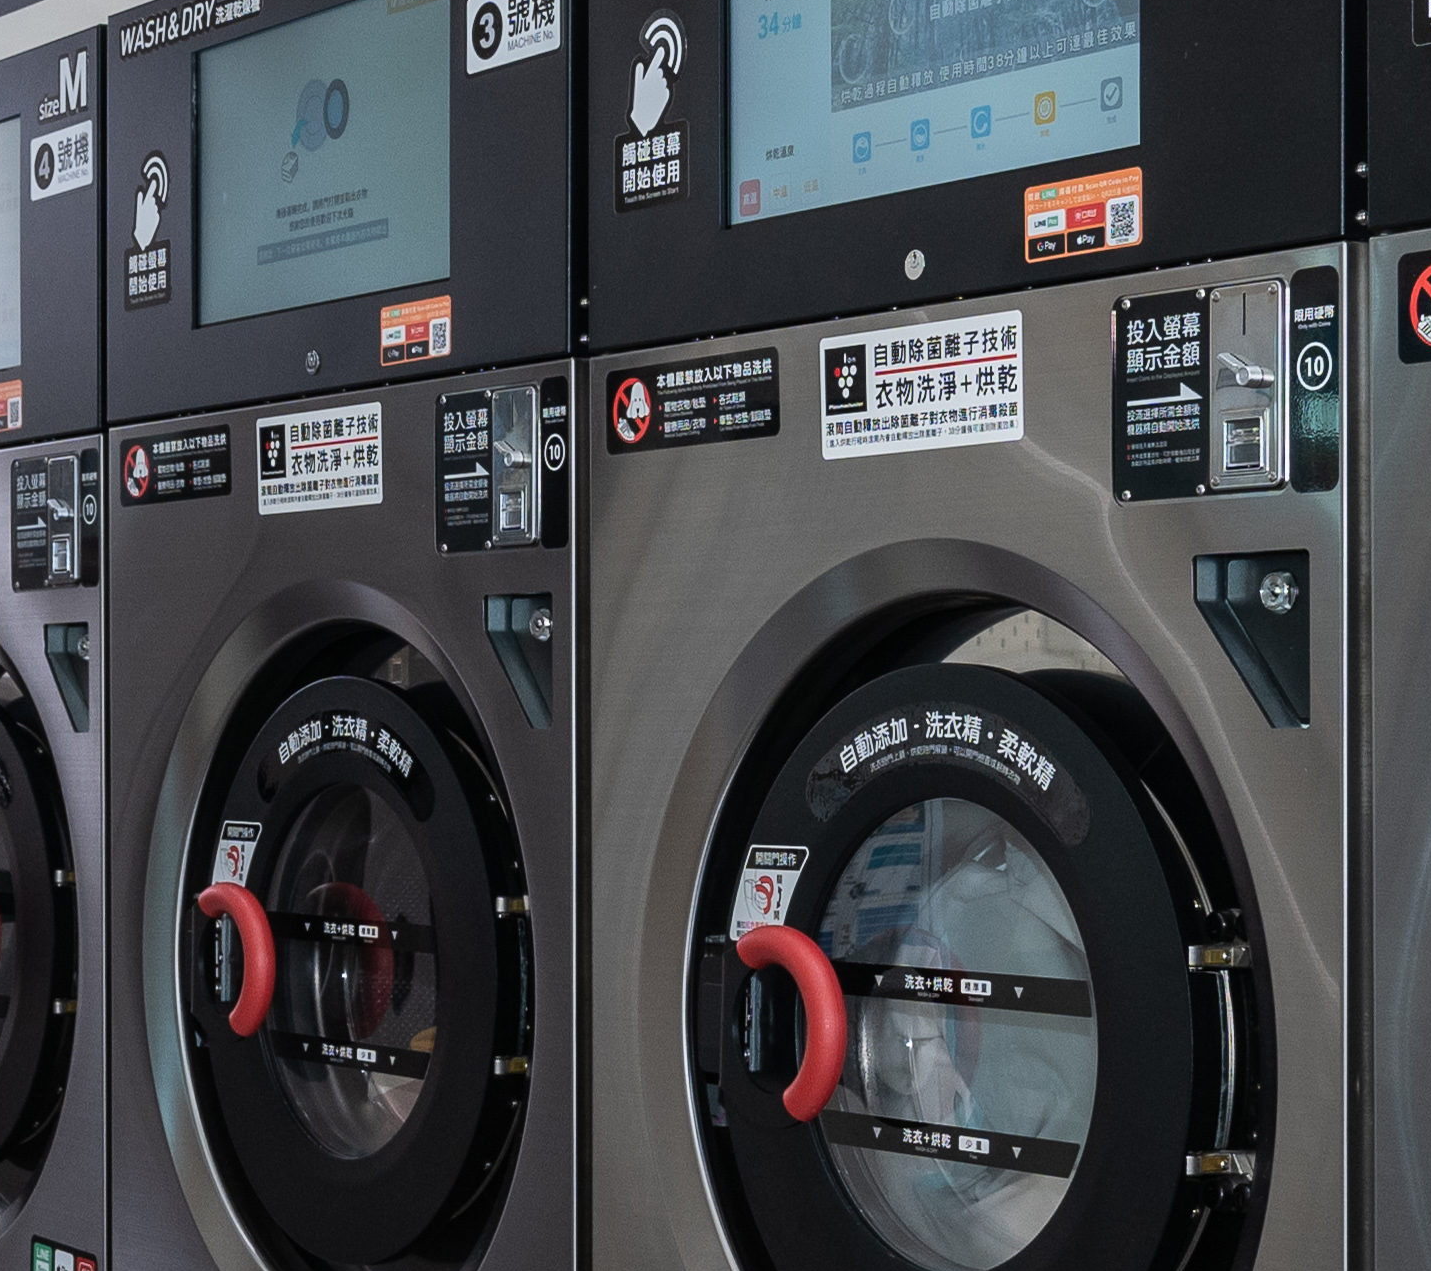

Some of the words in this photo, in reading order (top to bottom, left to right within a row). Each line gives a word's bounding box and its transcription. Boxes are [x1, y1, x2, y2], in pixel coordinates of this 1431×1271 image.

[479, 12, 495, 48] 3
[758, 12, 780, 39] 34
[507, 31, 541, 51] MACHINE
[543, 29, 555, 39] No.
[39, 97, 59, 120] size
[59, 51, 87, 114] M
[38, 151, 50, 180] 4
[58, 132, 89, 174] 號機
[1127, 312, 1200, 345] 投入螢幕
[874, 325, 1017, 368] 自動除菌離子技術
[1127, 341, 1200, 374] 顯示金額
[1304, 356, 1324, 377] 10
[290, 413, 378, 443] 自動除菌離子技術
[444, 408, 488, 432] 投入螢幕
[444, 430, 488, 454] 顯示金額
[549, 444, 560, 460] 10
[85, 503, 93, 516] 10
